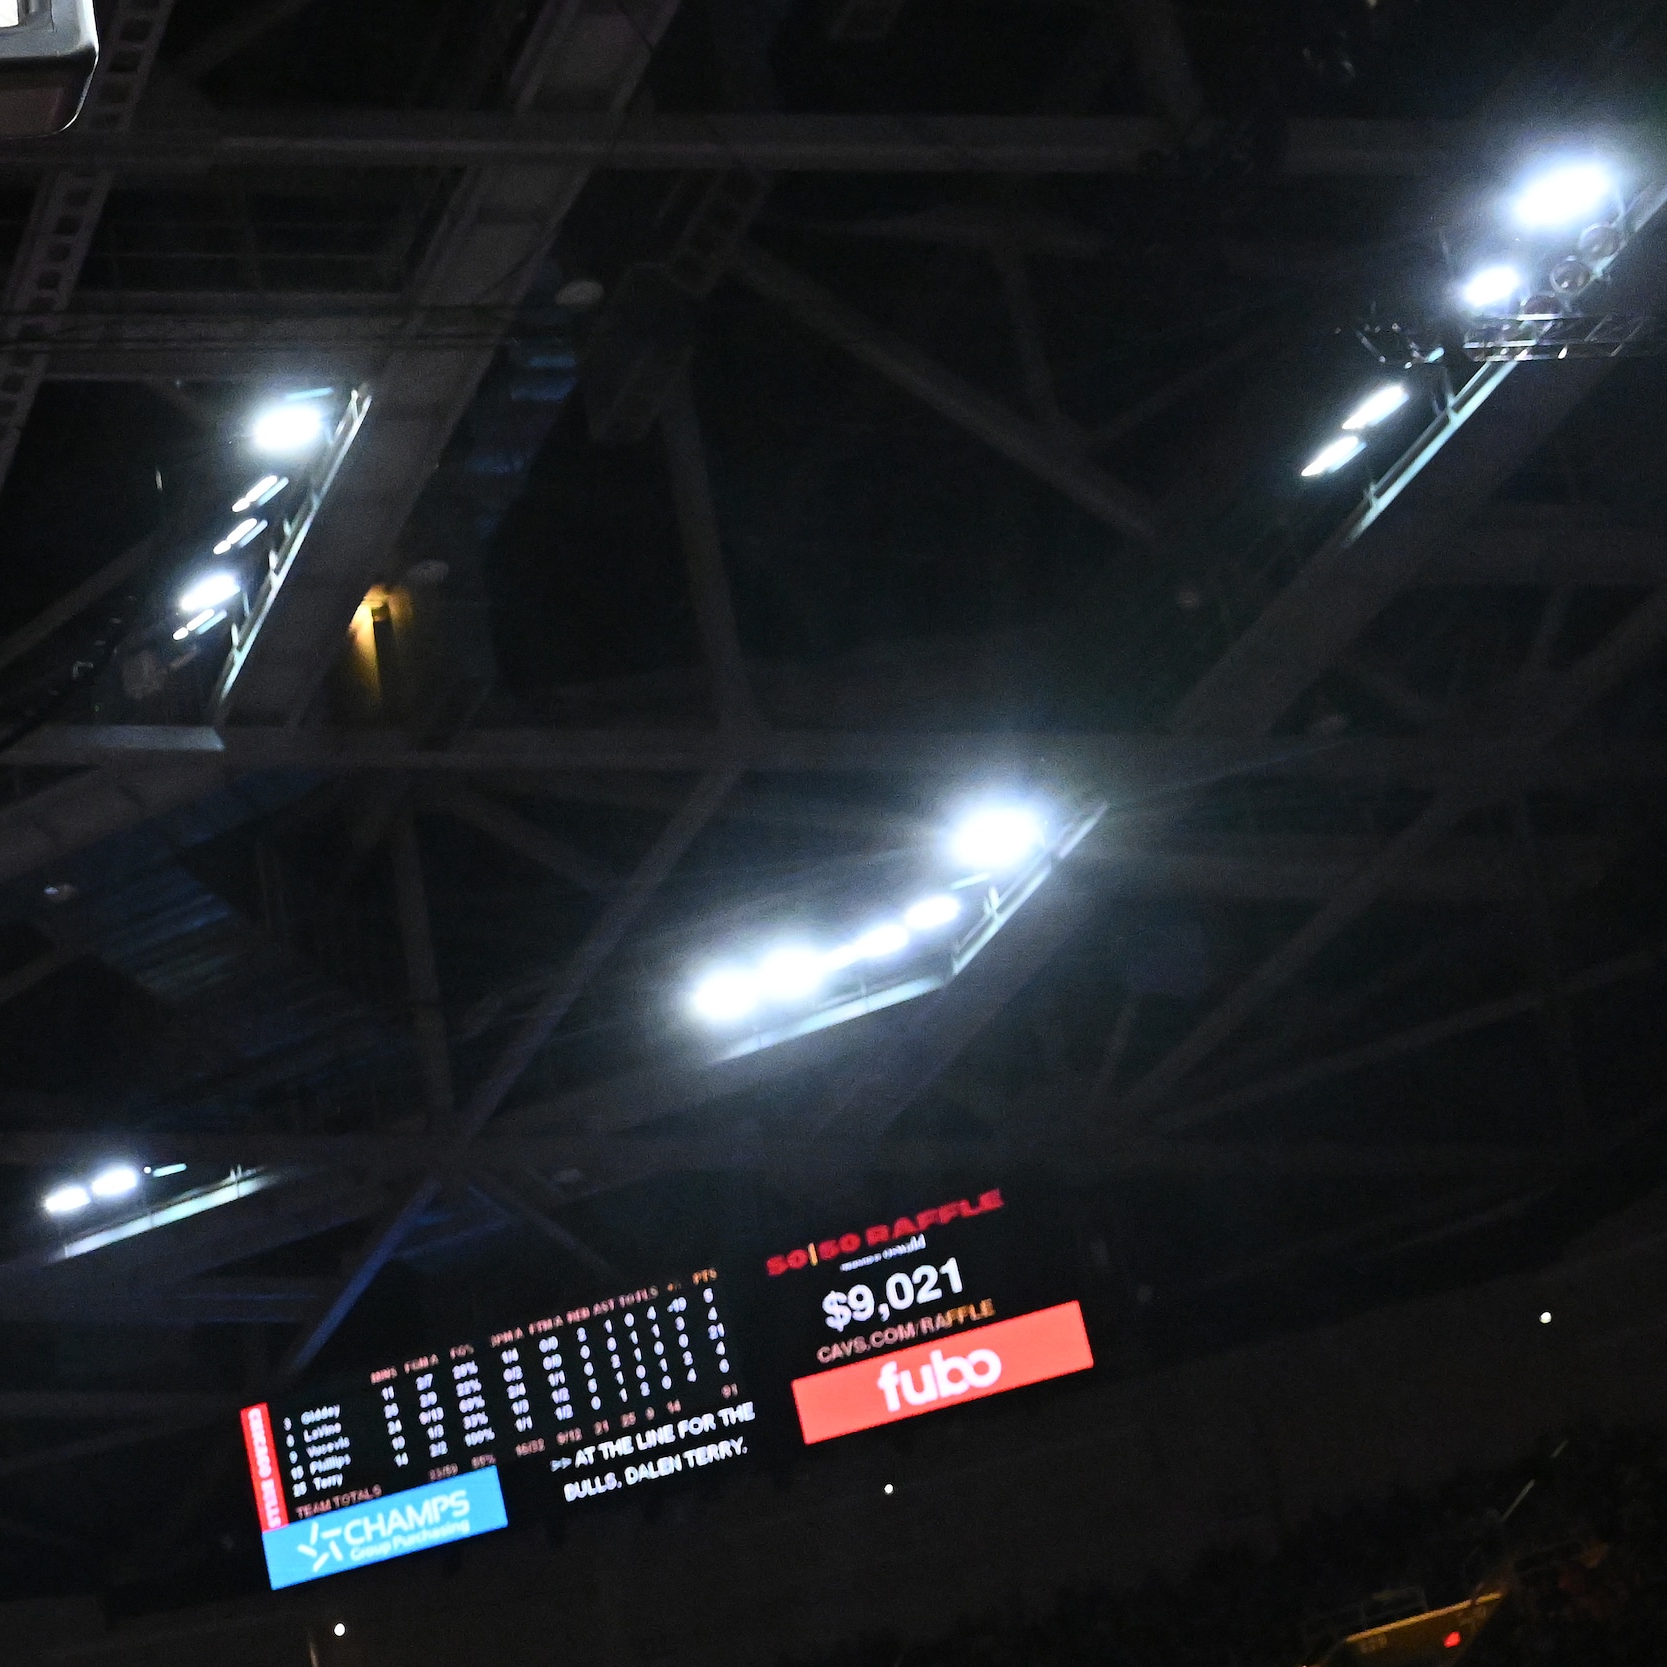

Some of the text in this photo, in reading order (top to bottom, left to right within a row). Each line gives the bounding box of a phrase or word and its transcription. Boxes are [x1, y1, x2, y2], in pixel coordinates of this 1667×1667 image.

[864, 1187, 1005, 1247] RAFFLE
[821, 1256, 964, 1333] $9,021
[877, 1348, 1003, 1413] fubo
[574, 1401, 756, 1468] AT THE LINE FOR THE
[624, 1453, 683, 1486] DALEN
[343, 1490, 471, 1545] CHAMPS
